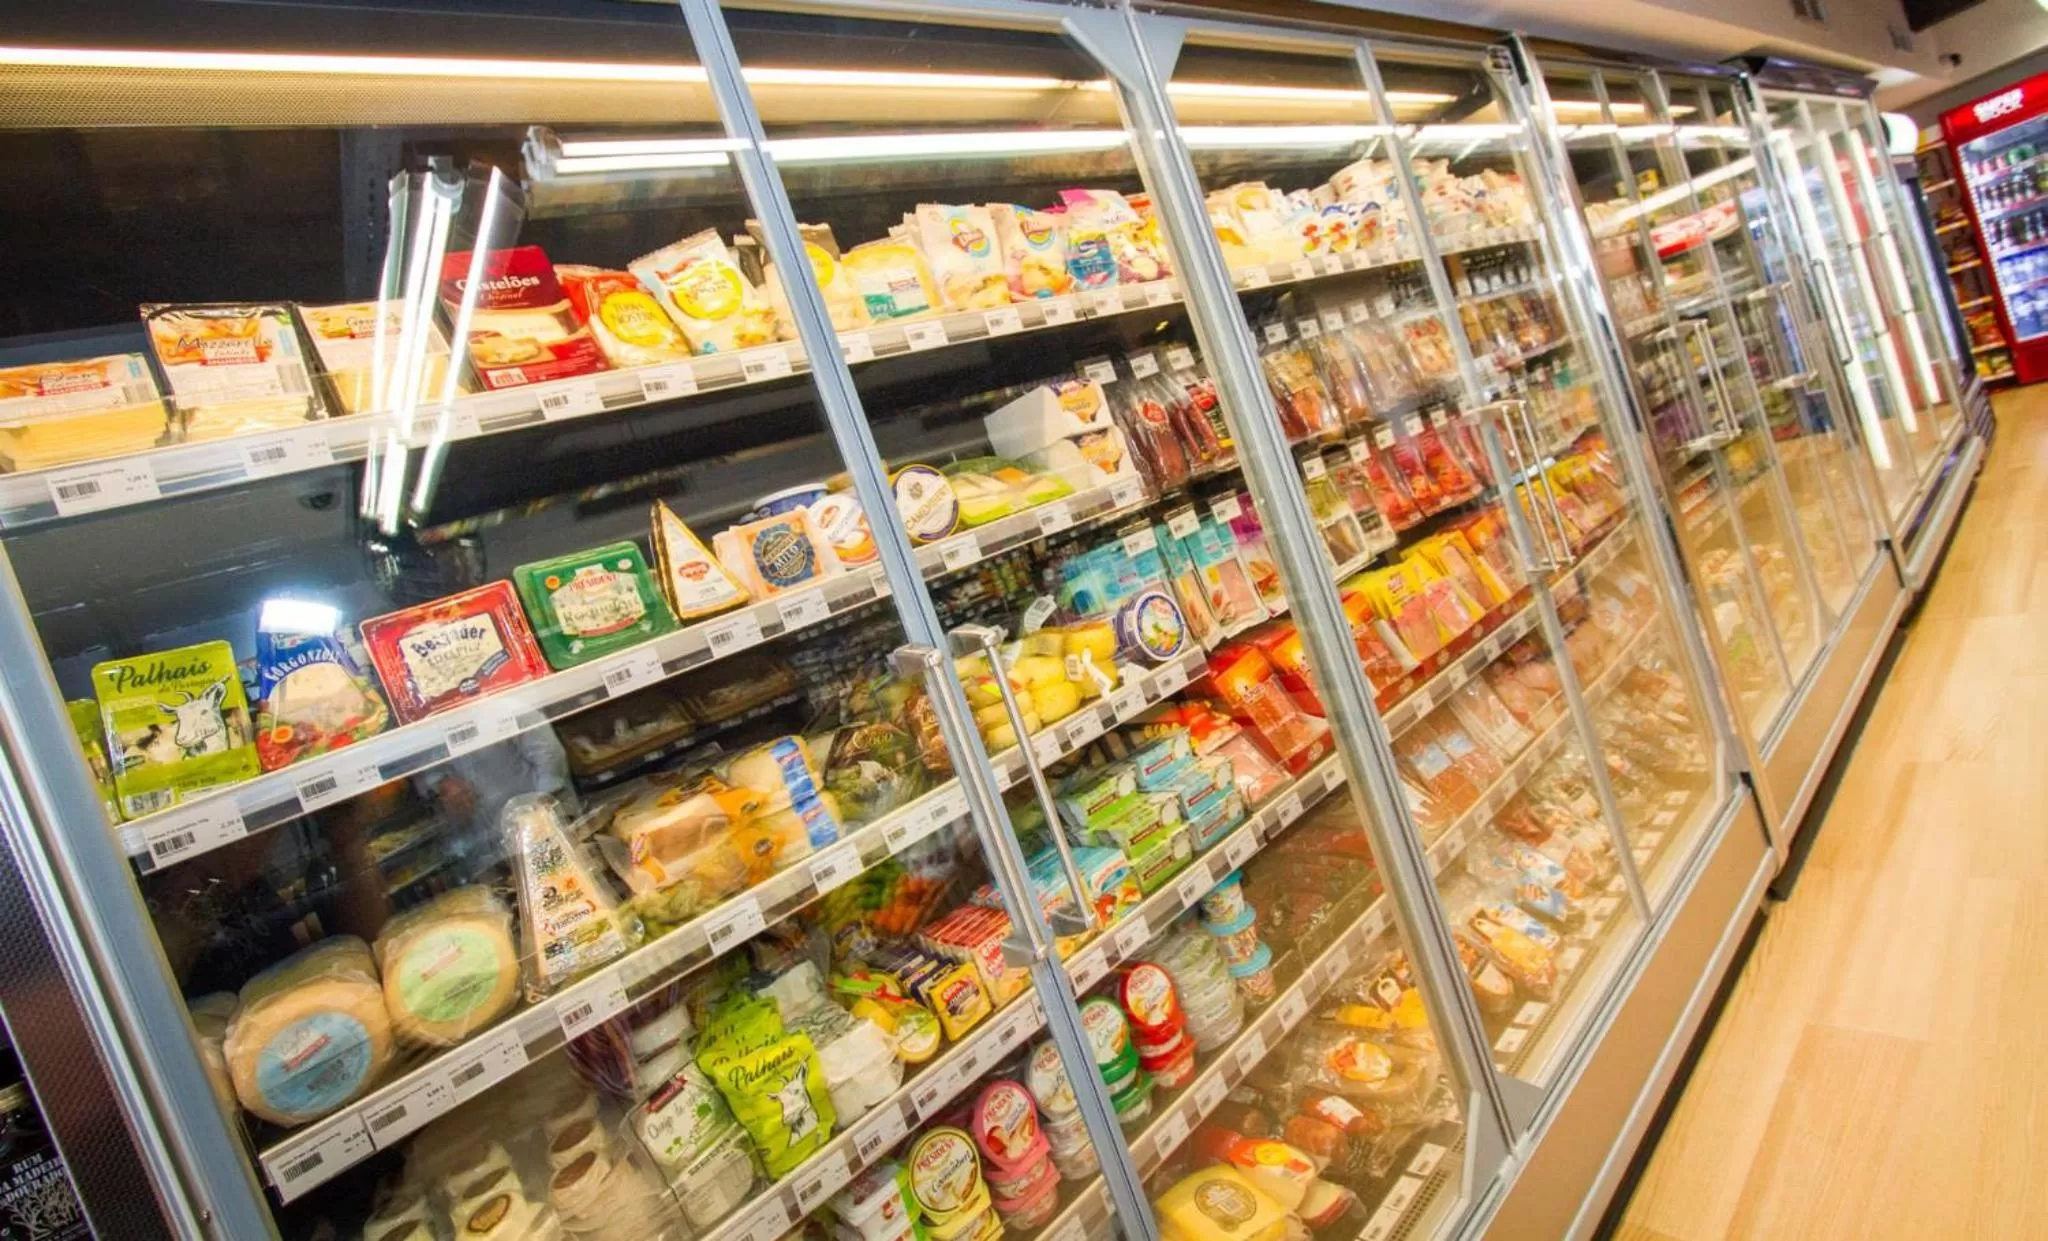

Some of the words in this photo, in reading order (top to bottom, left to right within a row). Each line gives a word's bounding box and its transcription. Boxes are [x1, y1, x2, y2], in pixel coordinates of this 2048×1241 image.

[456, 274, 541, 292] Cstelões
[109, 656, 212, 694] Palhais
[264, 646, 341, 683] GORGONZO
[728, 1046, 795, 1091] Palhais
[13, 1153, 44, 1175] RUM
